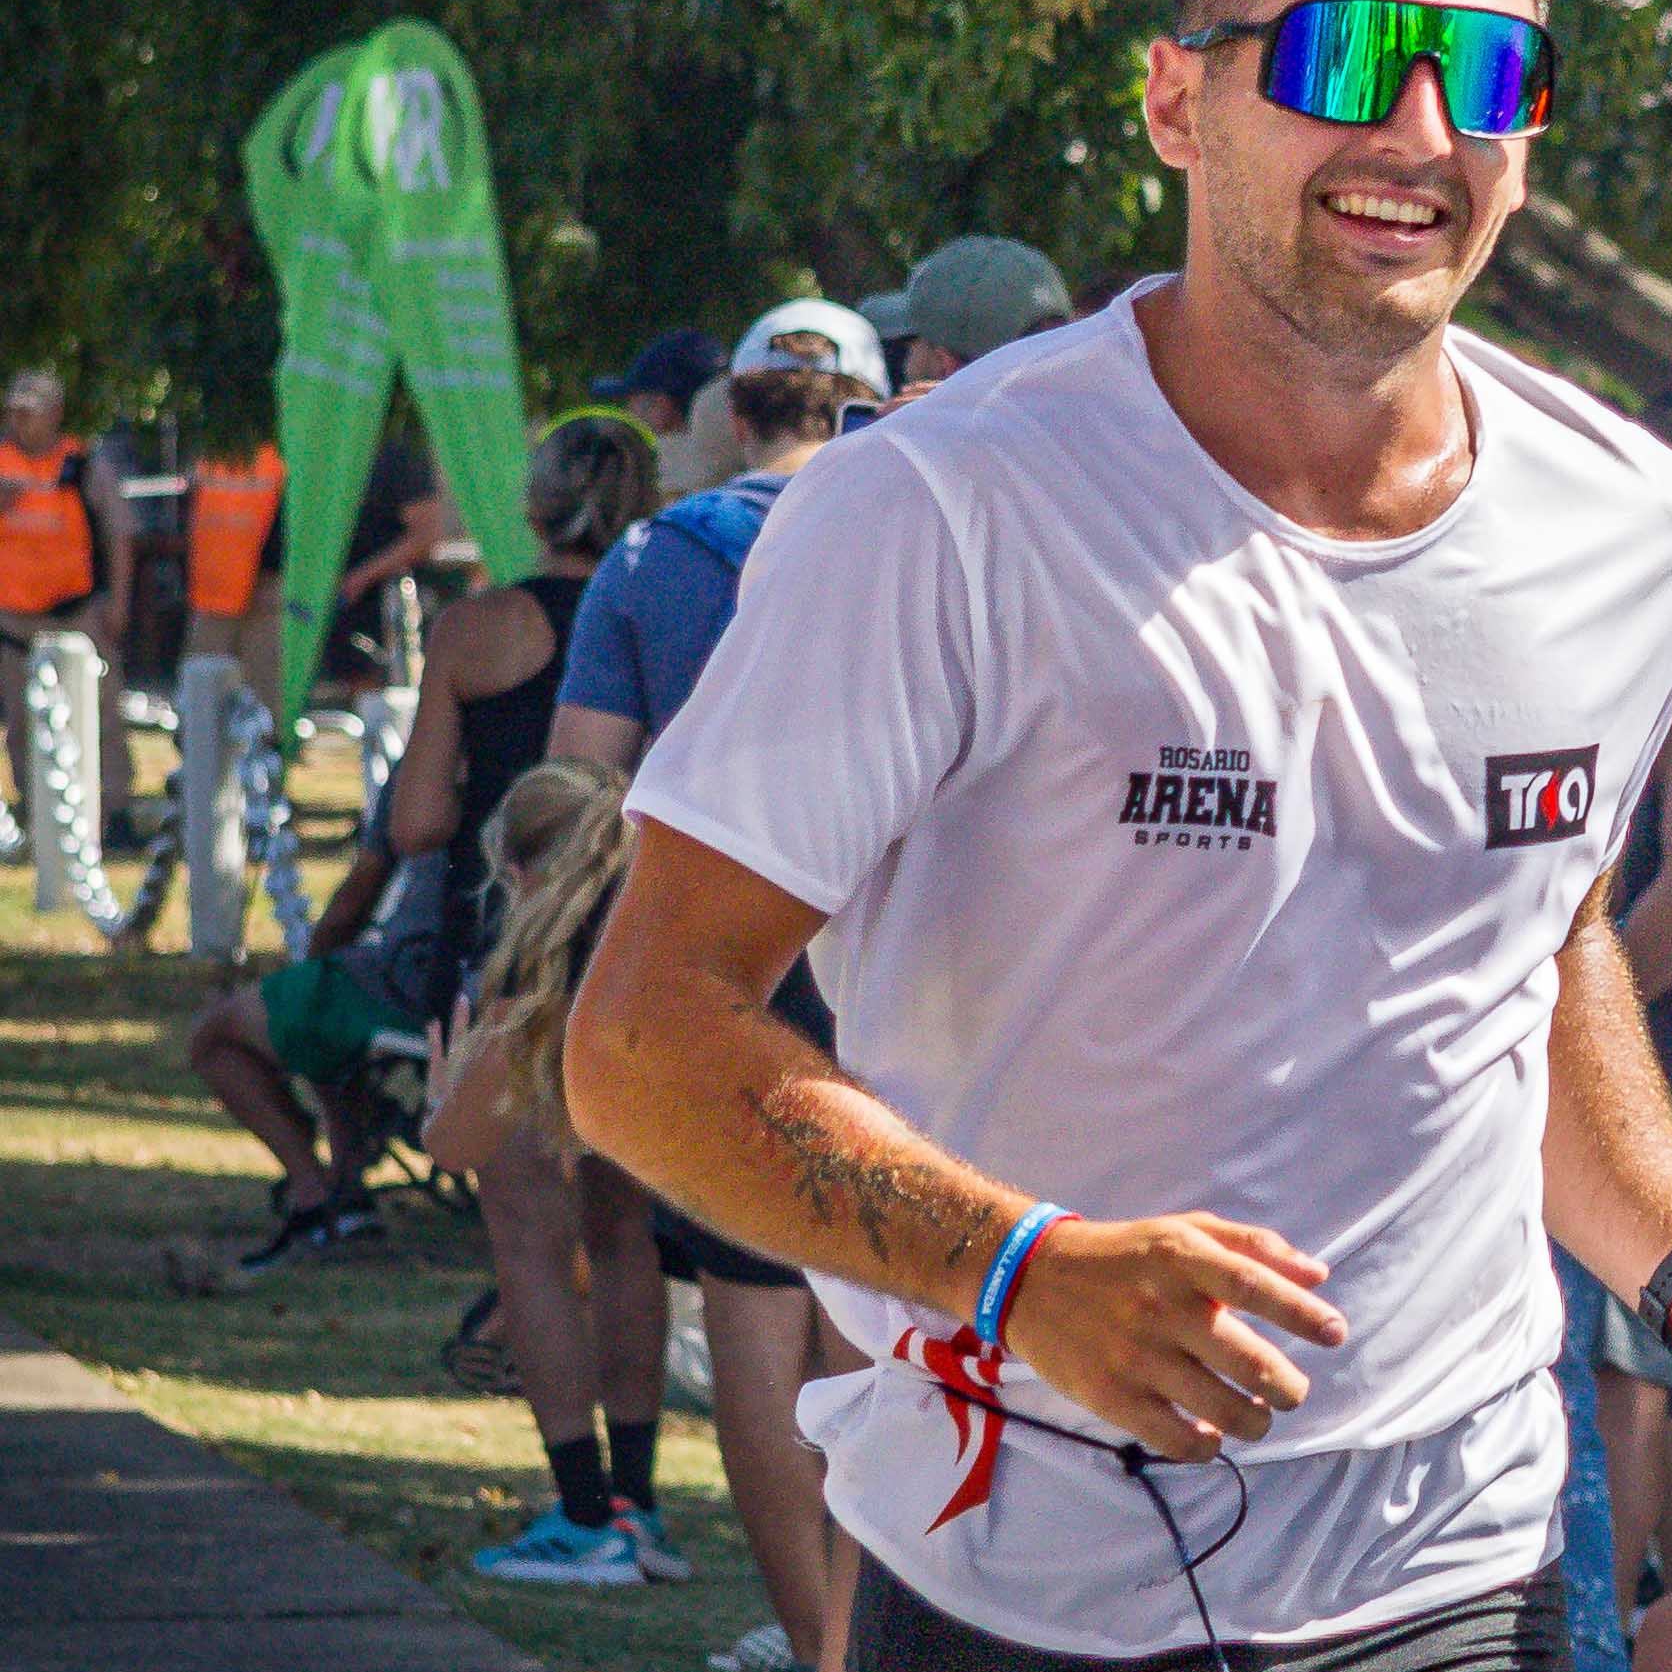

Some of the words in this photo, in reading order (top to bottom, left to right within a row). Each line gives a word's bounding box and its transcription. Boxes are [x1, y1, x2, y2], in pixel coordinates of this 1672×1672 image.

[1160, 746, 1250, 772] ROSARIO
[1119, 772, 1278, 838] ARENA
[1134, 830, 1252, 851] SPORTS
